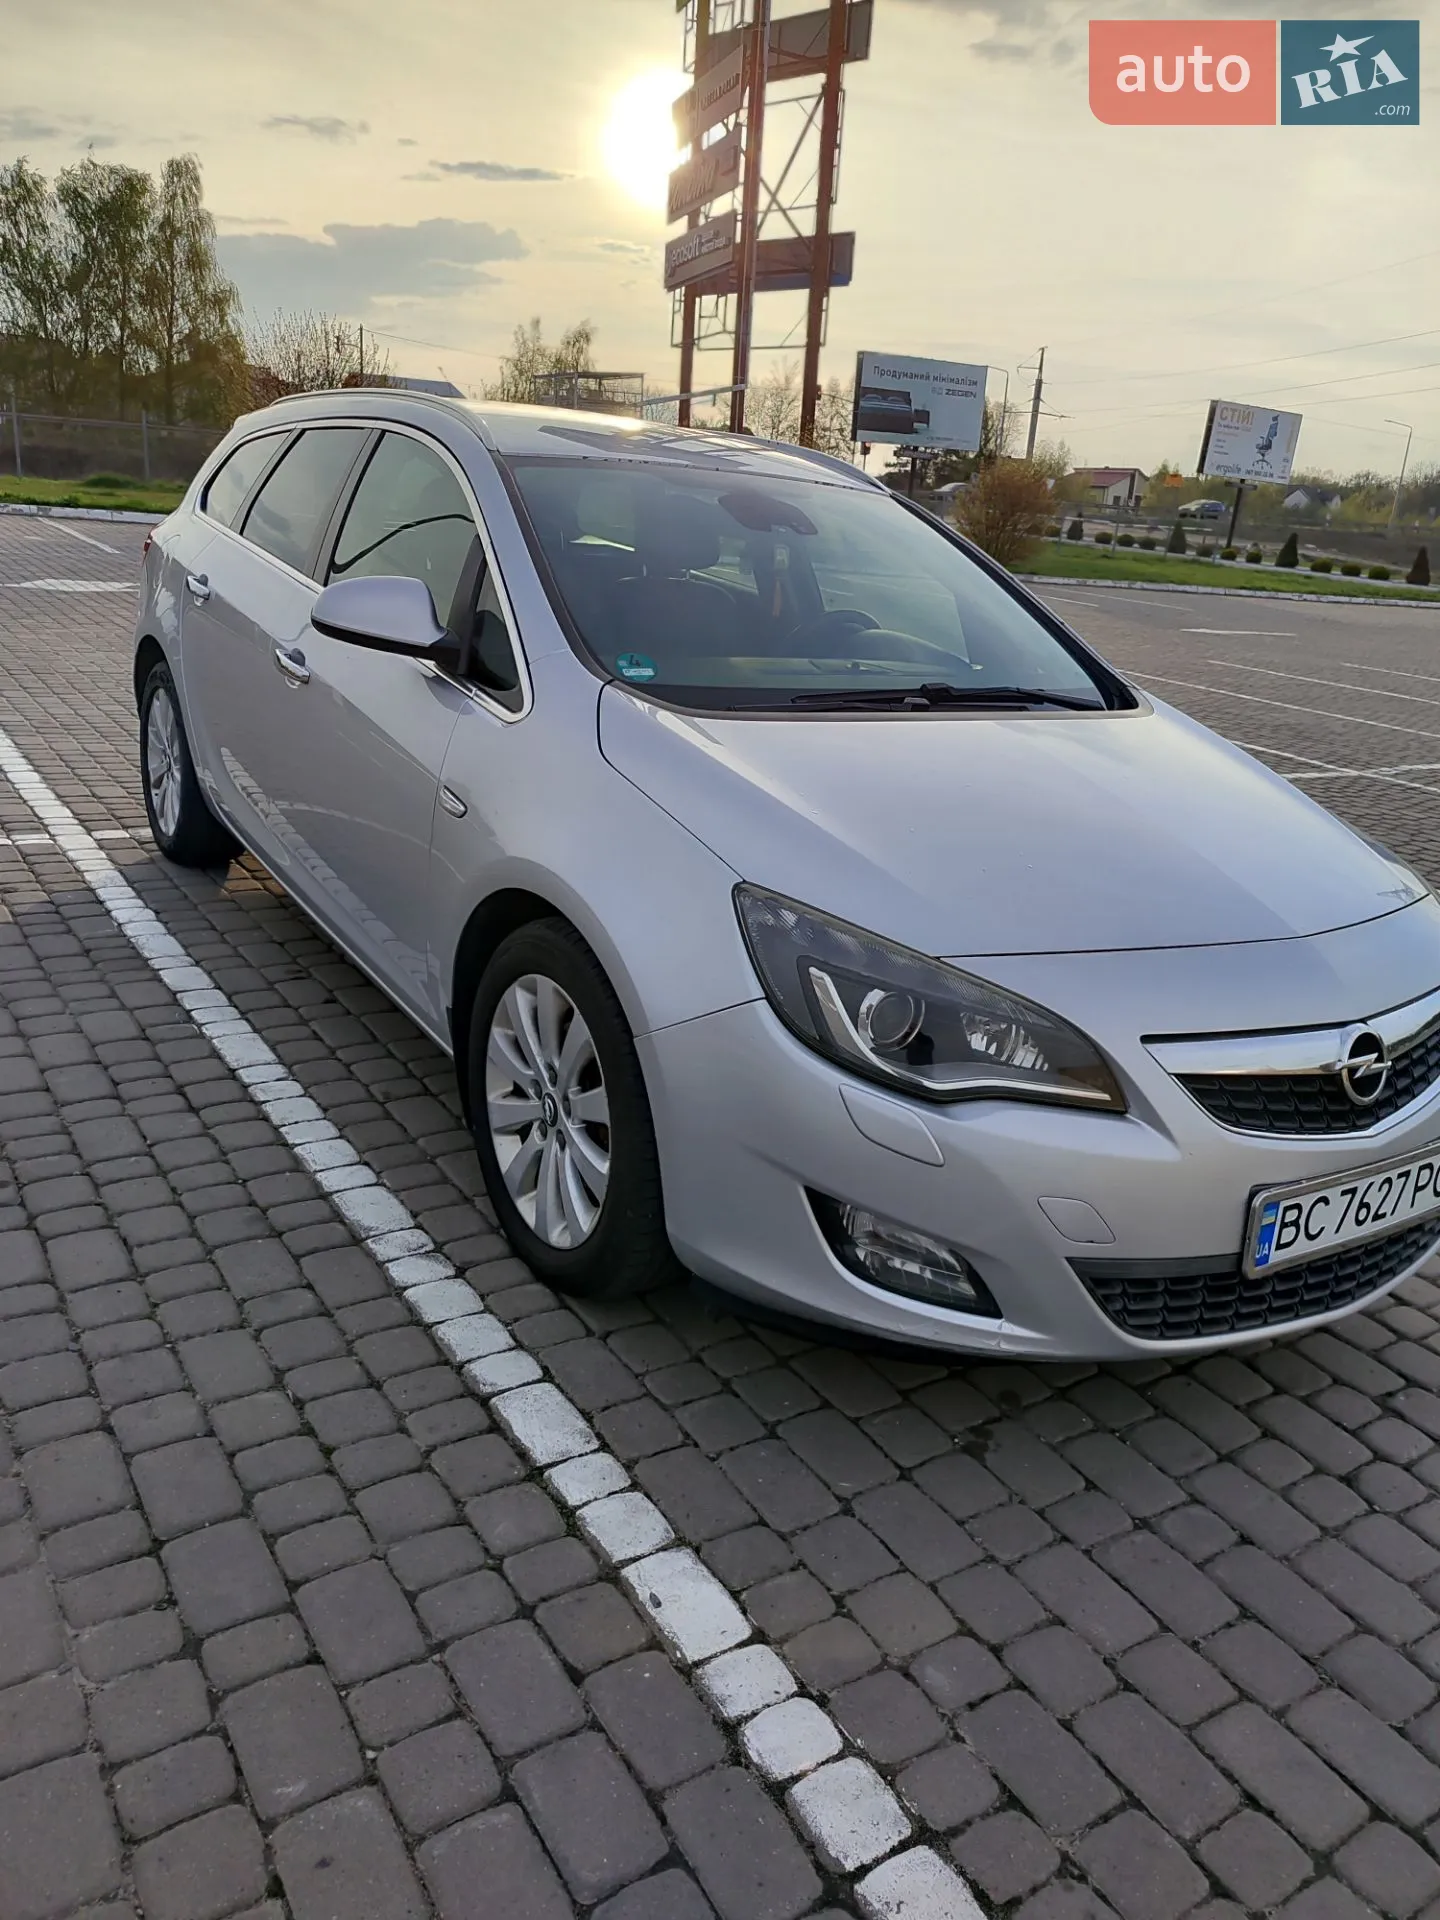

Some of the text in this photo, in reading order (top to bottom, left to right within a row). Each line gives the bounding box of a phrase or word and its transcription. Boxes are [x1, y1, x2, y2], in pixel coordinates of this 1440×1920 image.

[873, 365, 978, 387] Продуманий мінімалізм
[945, 388, 977, 399] ZEGEN
[1274, 1195, 1331, 1252] BC
[1334, 1168, 1412, 1235] 7627
[1255, 1243, 1270, 1258] UA
